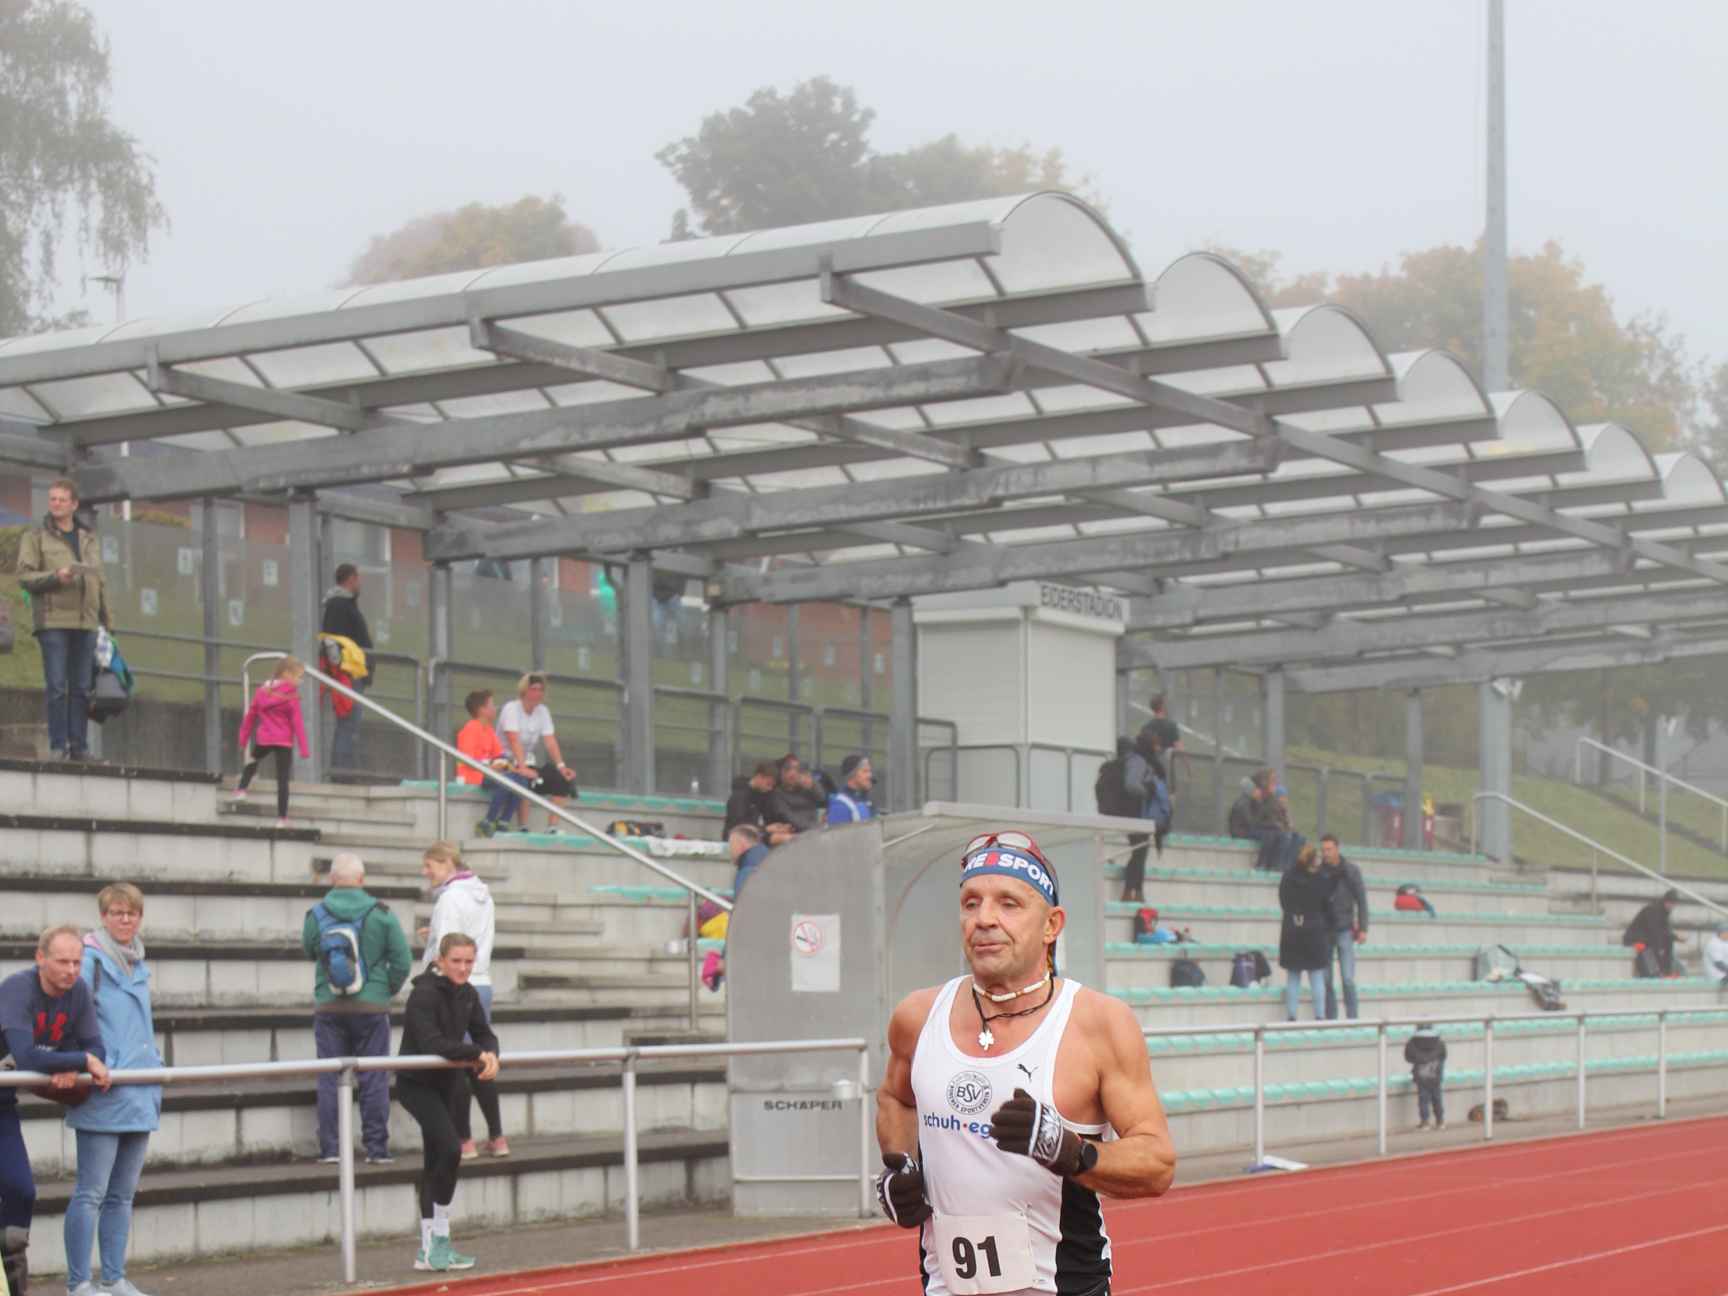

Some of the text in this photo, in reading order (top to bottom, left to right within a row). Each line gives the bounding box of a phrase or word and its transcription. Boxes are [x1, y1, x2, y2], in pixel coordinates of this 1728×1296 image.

[1041, 584, 1122, 620] EIDERSTADION
[956, 1083, 982, 1103] BSV
[952, 1235, 1002, 1280] 91
